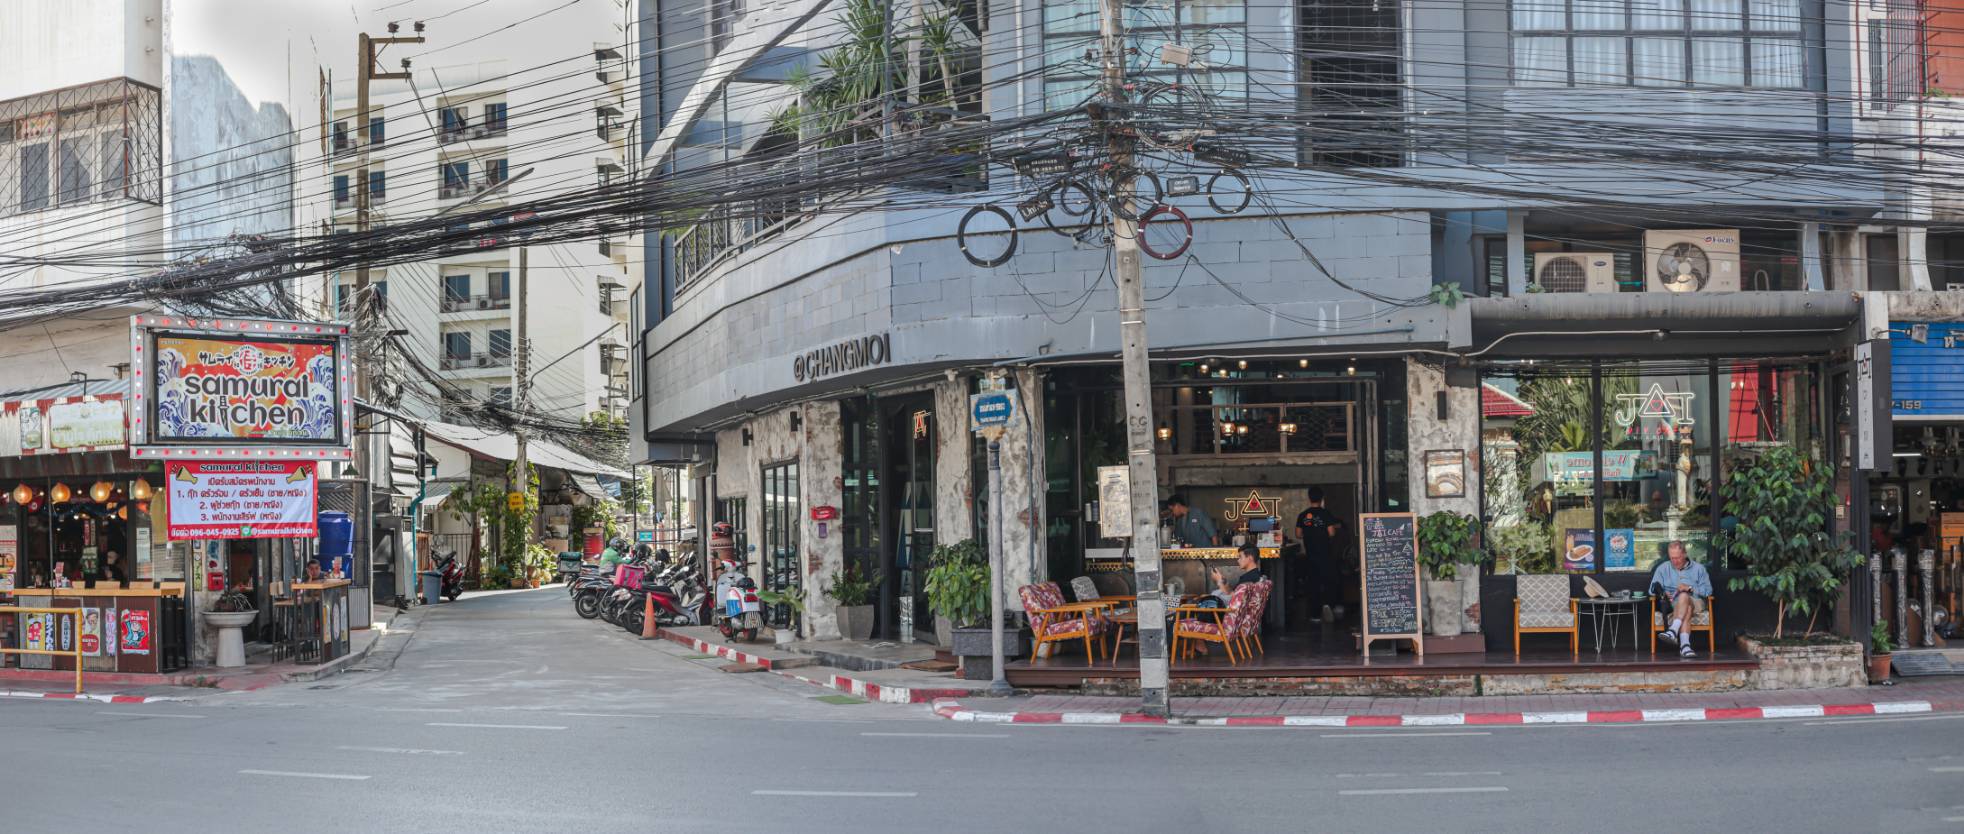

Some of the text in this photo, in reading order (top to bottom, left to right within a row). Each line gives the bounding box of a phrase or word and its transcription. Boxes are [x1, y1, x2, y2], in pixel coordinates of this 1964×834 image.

[793, 333, 892, 382] @CHANGMOI
[184, 374, 309, 398] samurai
[1891, 400, 1921, 410] -159
[190, 396, 305, 432] kitchen
[200, 463, 285, 473] samurai kitchen
[177, 490, 185, 498] 1.
[200, 501, 208, 510] 2.
[201, 513, 209, 521] 3.
[190, 527, 240, 536] 096-045-0925
